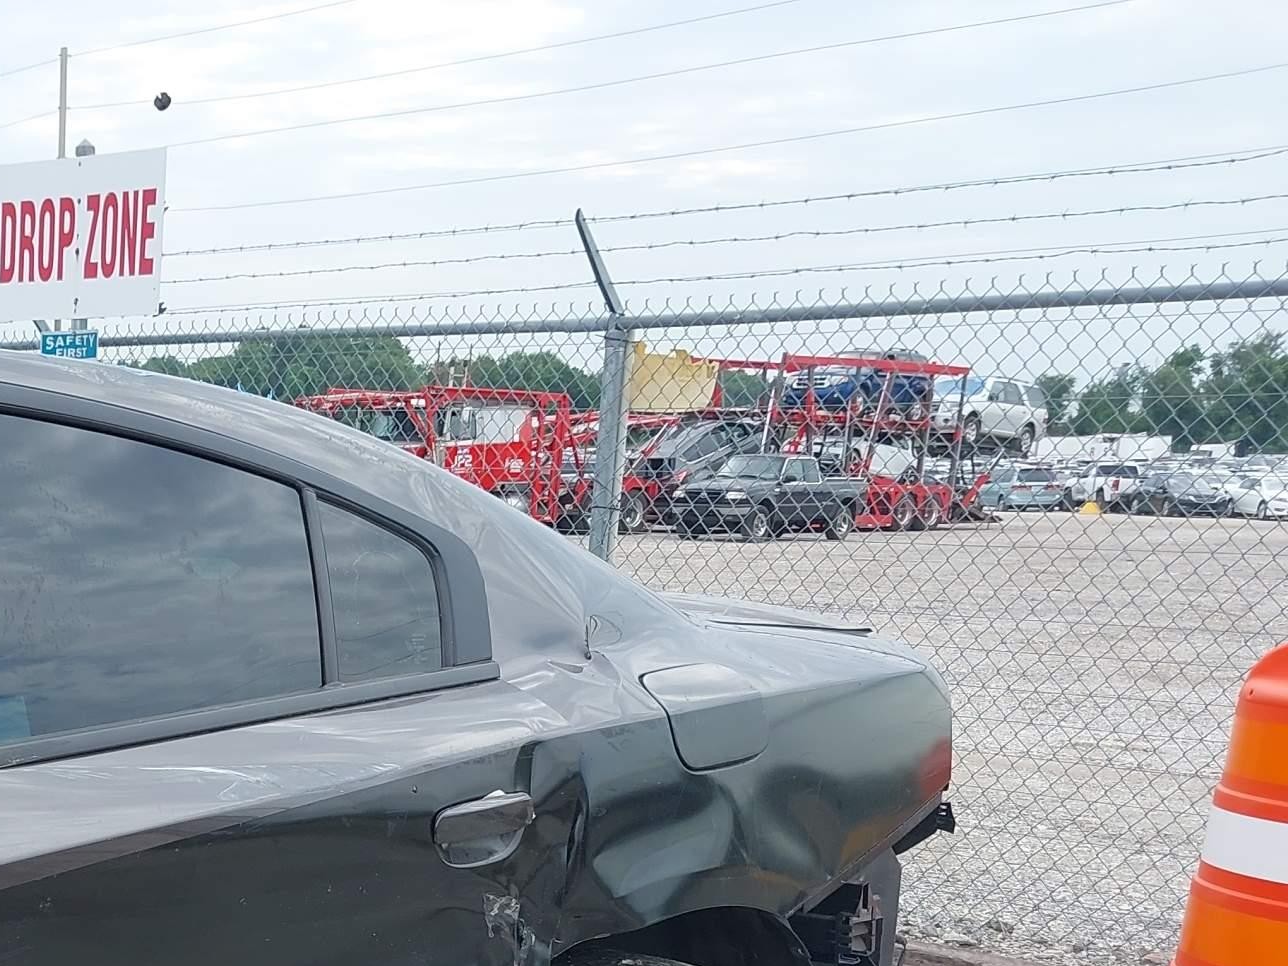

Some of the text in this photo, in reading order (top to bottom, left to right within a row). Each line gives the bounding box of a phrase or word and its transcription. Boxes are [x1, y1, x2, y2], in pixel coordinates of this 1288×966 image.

[0, 188, 157, 283] DROP ZONE
[45, 334, 95, 350] SAFETY
[56, 347, 87, 358] FIRST
